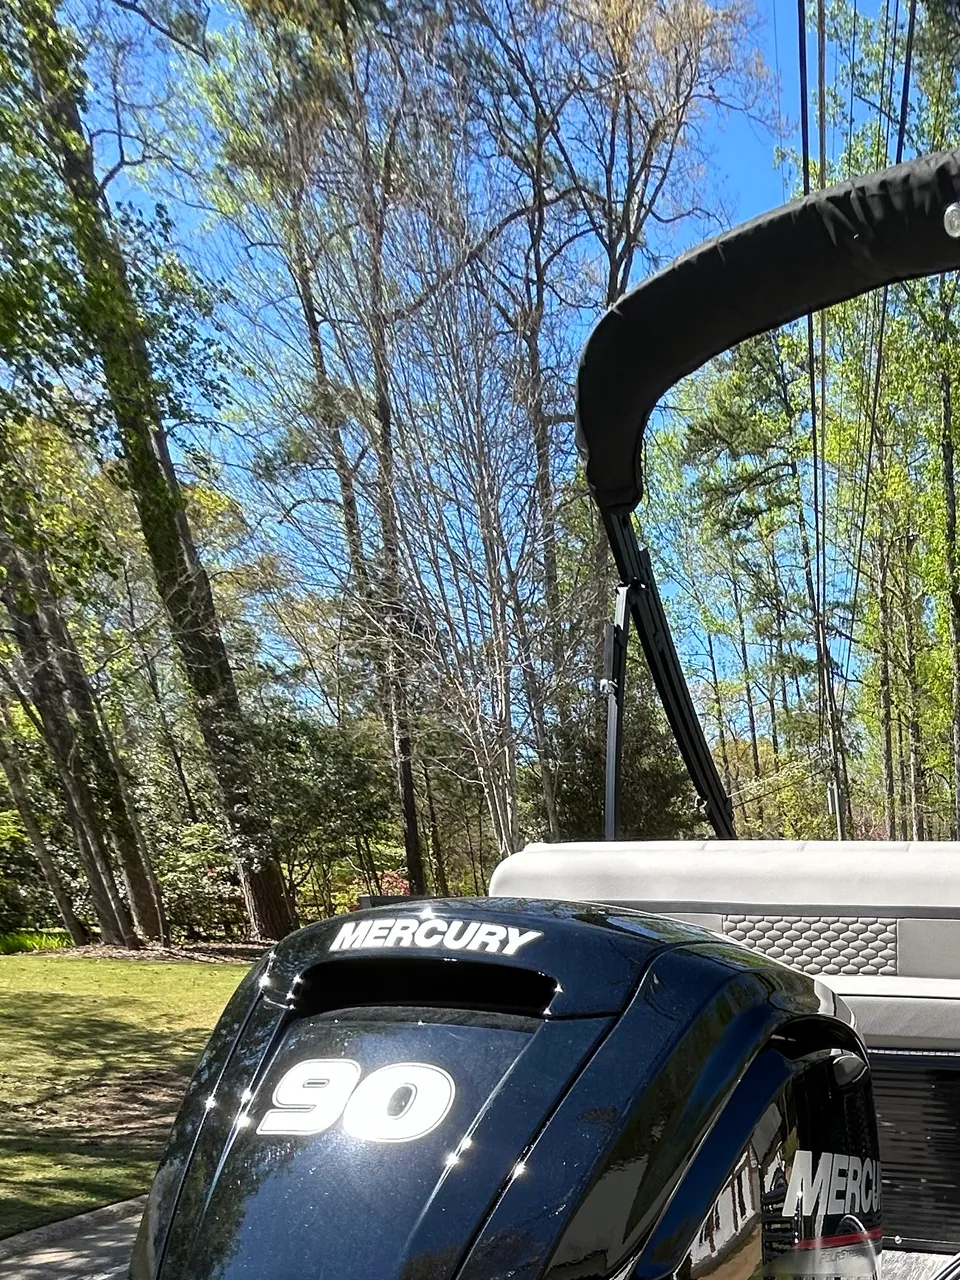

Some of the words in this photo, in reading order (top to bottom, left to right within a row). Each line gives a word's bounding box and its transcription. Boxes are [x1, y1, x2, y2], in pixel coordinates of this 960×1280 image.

[328, 919, 544, 956] MERCURY
[256, 1058, 455, 1143] 90
[782, 1150, 880, 1217] MERCU
